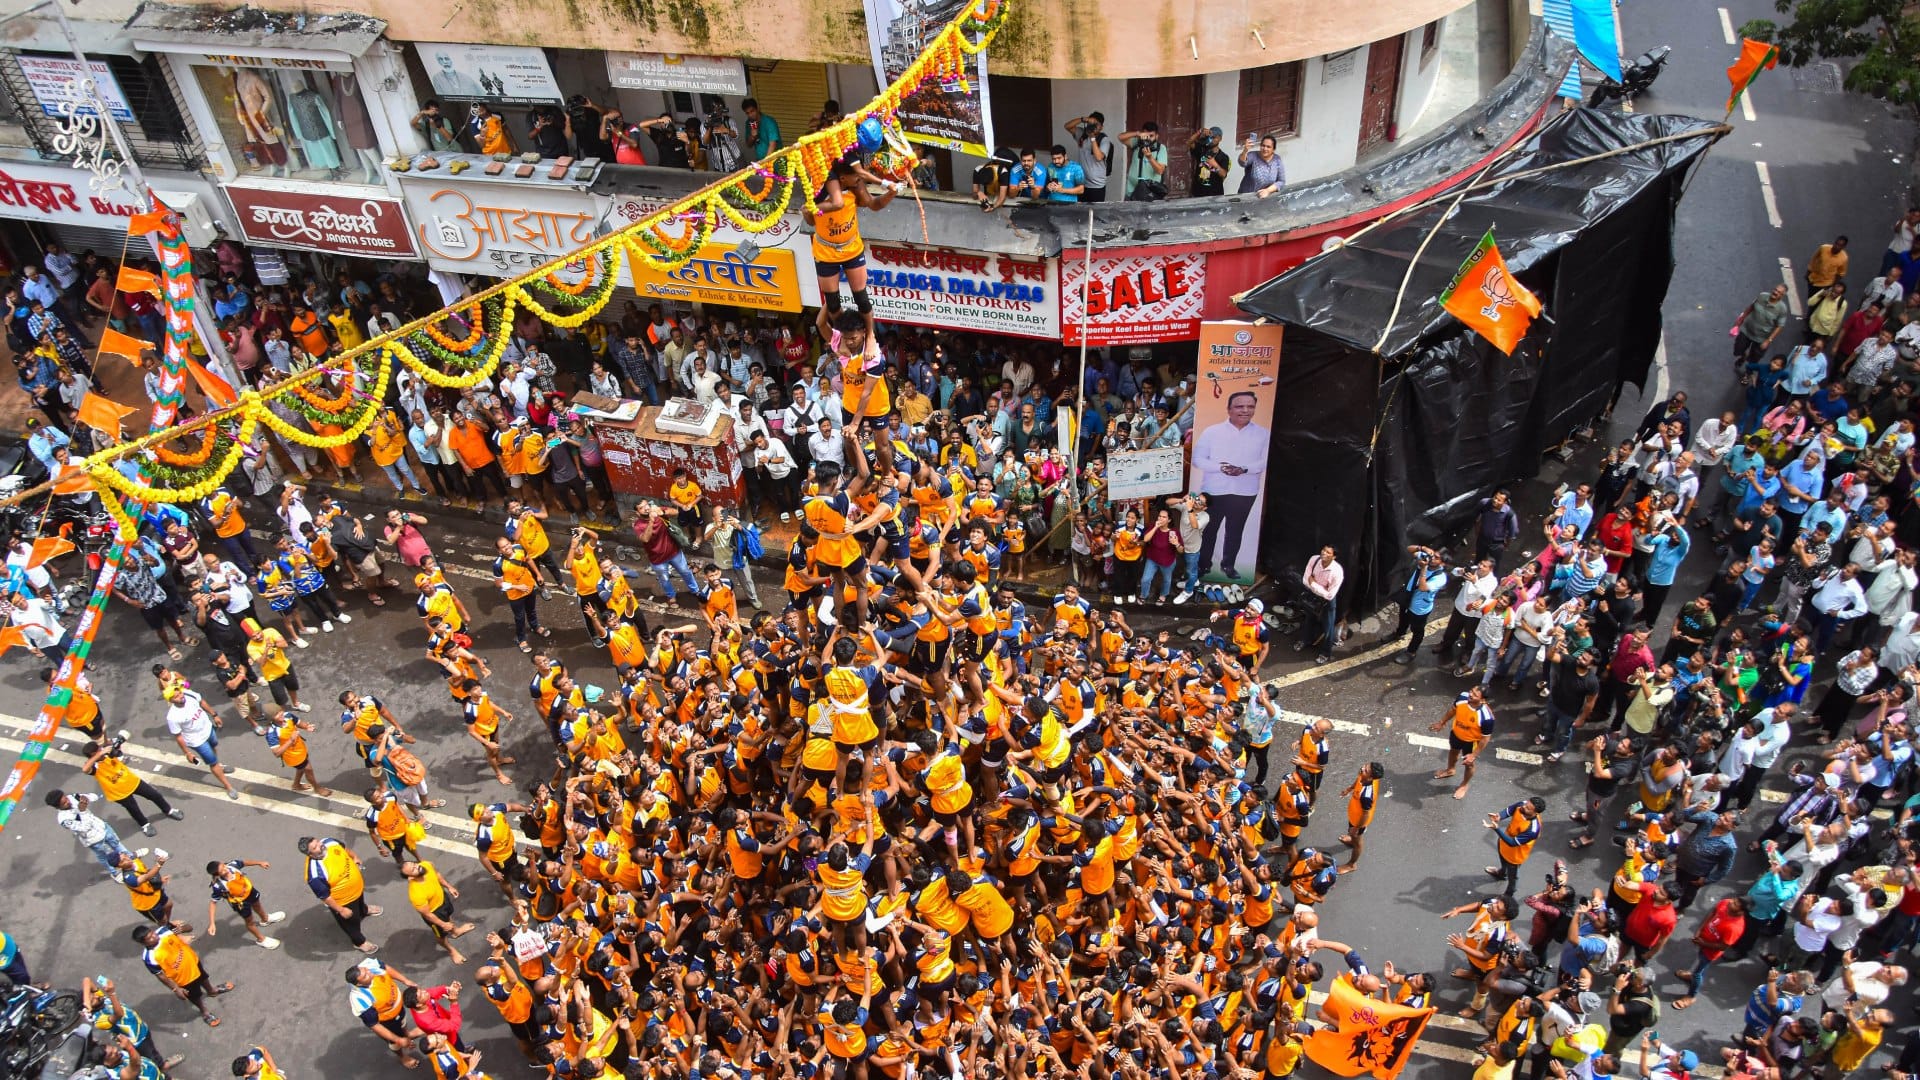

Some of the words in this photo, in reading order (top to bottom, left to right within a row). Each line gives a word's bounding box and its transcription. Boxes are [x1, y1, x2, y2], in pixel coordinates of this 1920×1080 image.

[89, 197, 139, 217] BLAZ
[249, 205, 323, 242] जनता
[325, 232, 359, 245] JANATA
[361, 237, 396, 248] STORES
[650, 250, 779, 288] हावीर
[698, 289, 726, 302] Ethnic
[728, 292, 737, 302] &
[866, 285, 926, 301] CHOOL
[931, 293, 1032, 313] UNIFORMS
[948, 277, 1044, 303] DRAPERS
[1079, 260, 1190, 317] SALE
[869, 297, 927, 312] OLLECTION
[928, 304, 952, 315] FOR
[955, 305, 980, 317] NEW
[983, 310, 1015, 322] BORN
[1017, 313, 1047, 325] BABY
[1153, 323, 1169, 331] Kids
[1170, 322, 1190, 330] Wear
[1211, 344, 1274, 359] भाजपा
